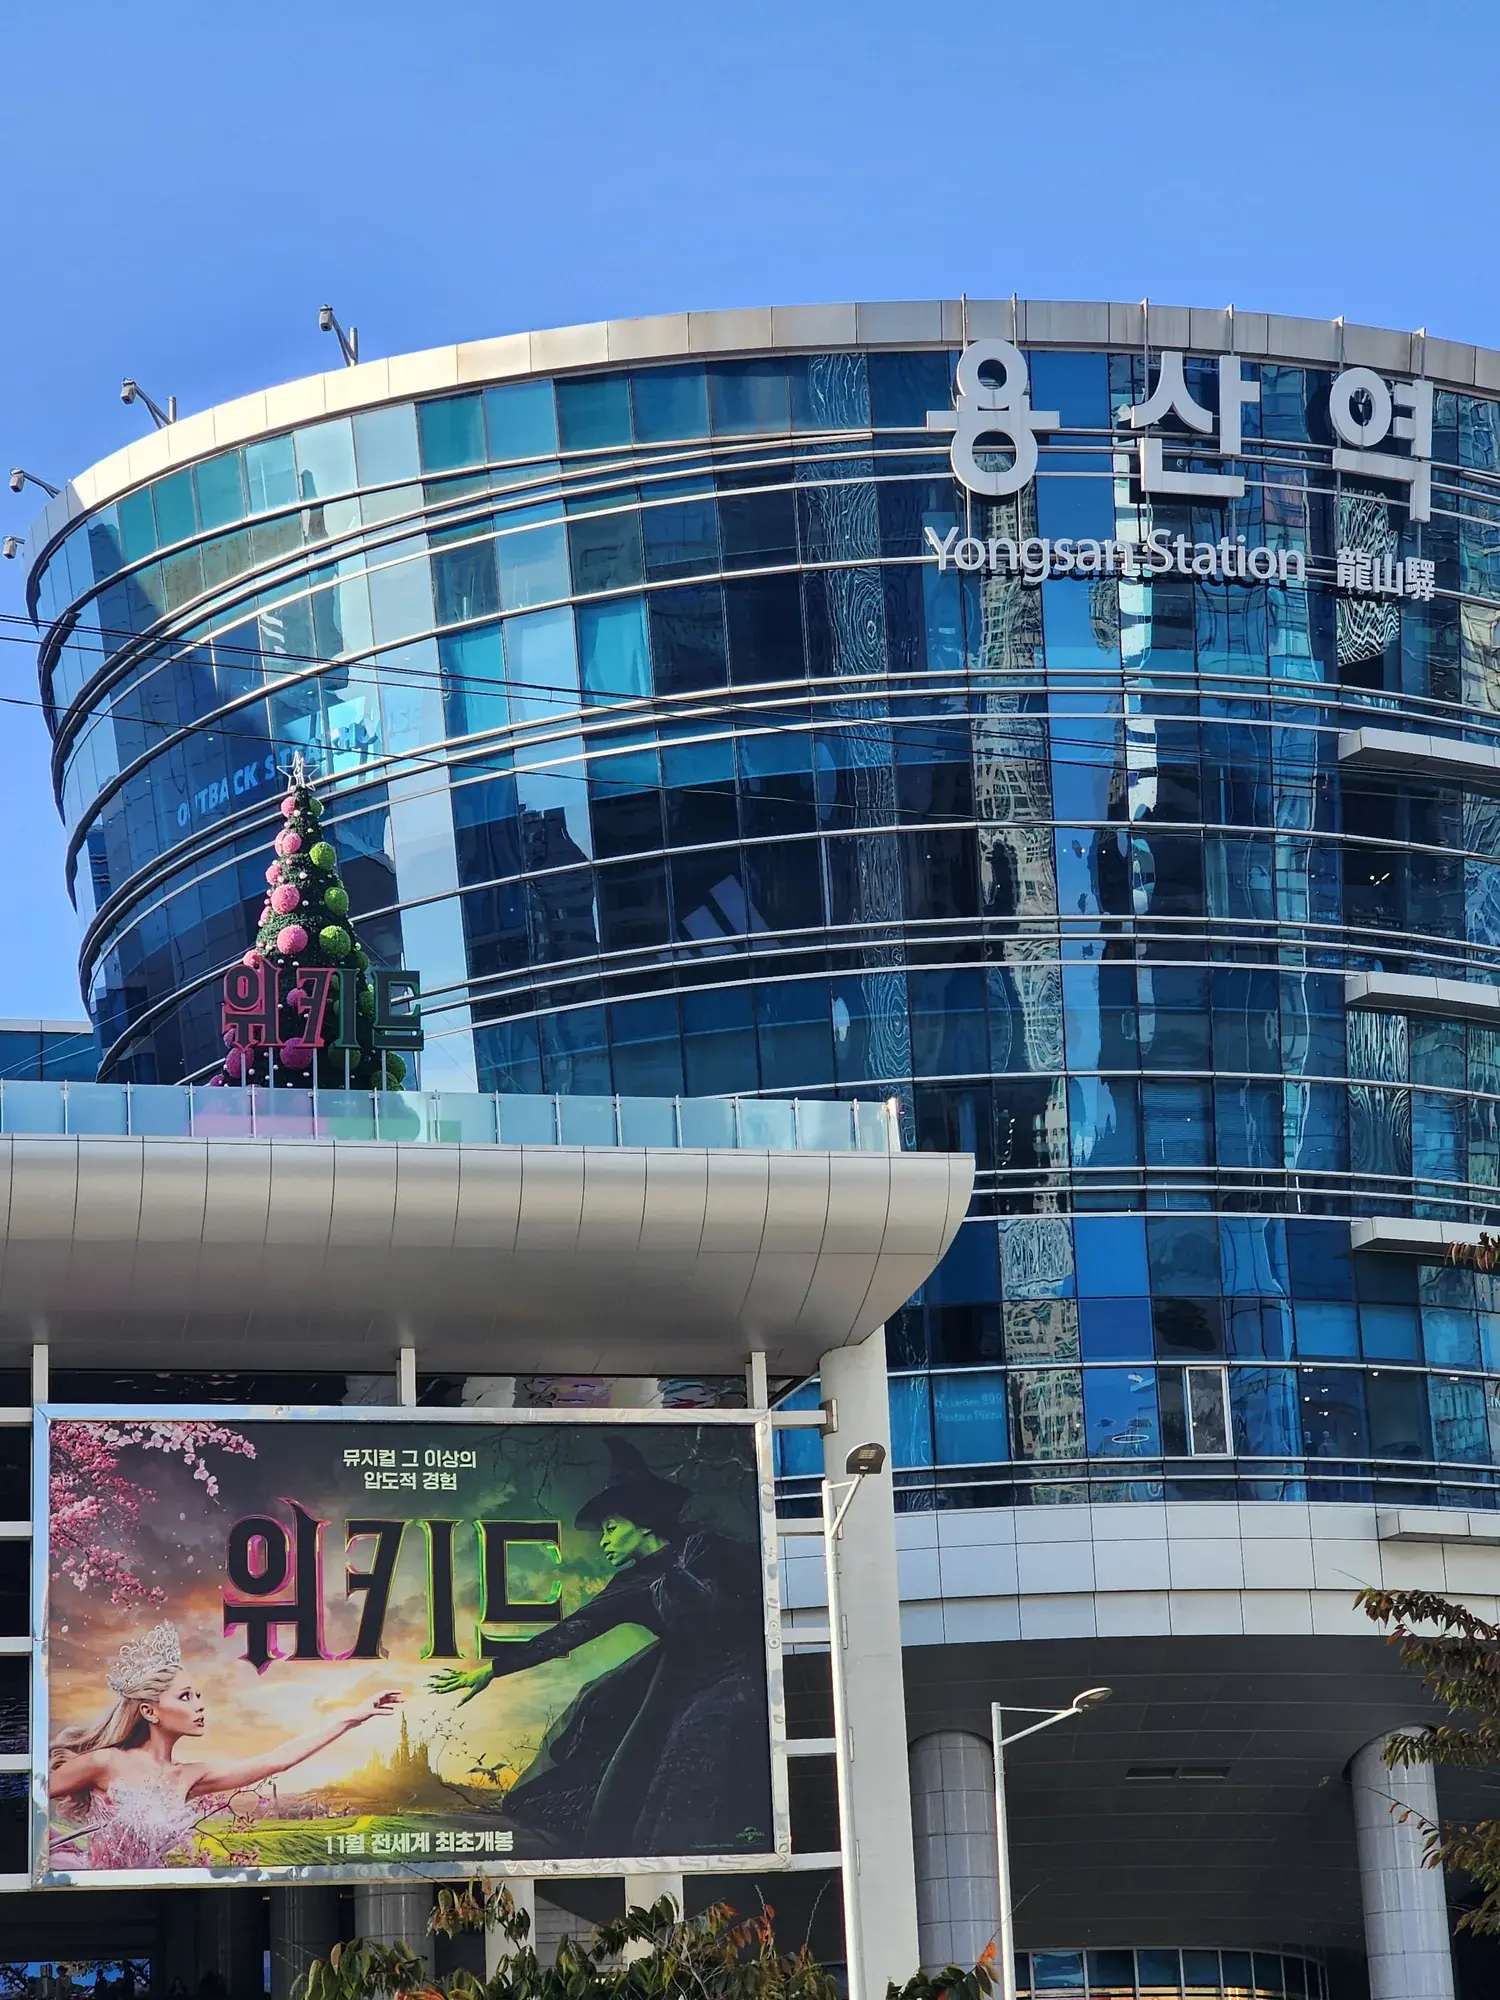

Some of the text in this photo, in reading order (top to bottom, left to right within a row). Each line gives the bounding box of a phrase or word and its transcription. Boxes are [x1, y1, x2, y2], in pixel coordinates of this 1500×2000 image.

[926, 338, 1434, 522] 용산역
[925, 526, 1306, 582] Yongsan Station
[177, 762, 259, 827] OTBACK
[222, 956, 425, 1051] 위키드
[343, 1449, 477, 1468] 뮤지컬 그 이상의
[363, 1471, 458, 1491] 압도적 경험
[223, 1497, 571, 1675] 위키드
[325, 1830, 514, 1855] 11월 전세계 최초개봉
